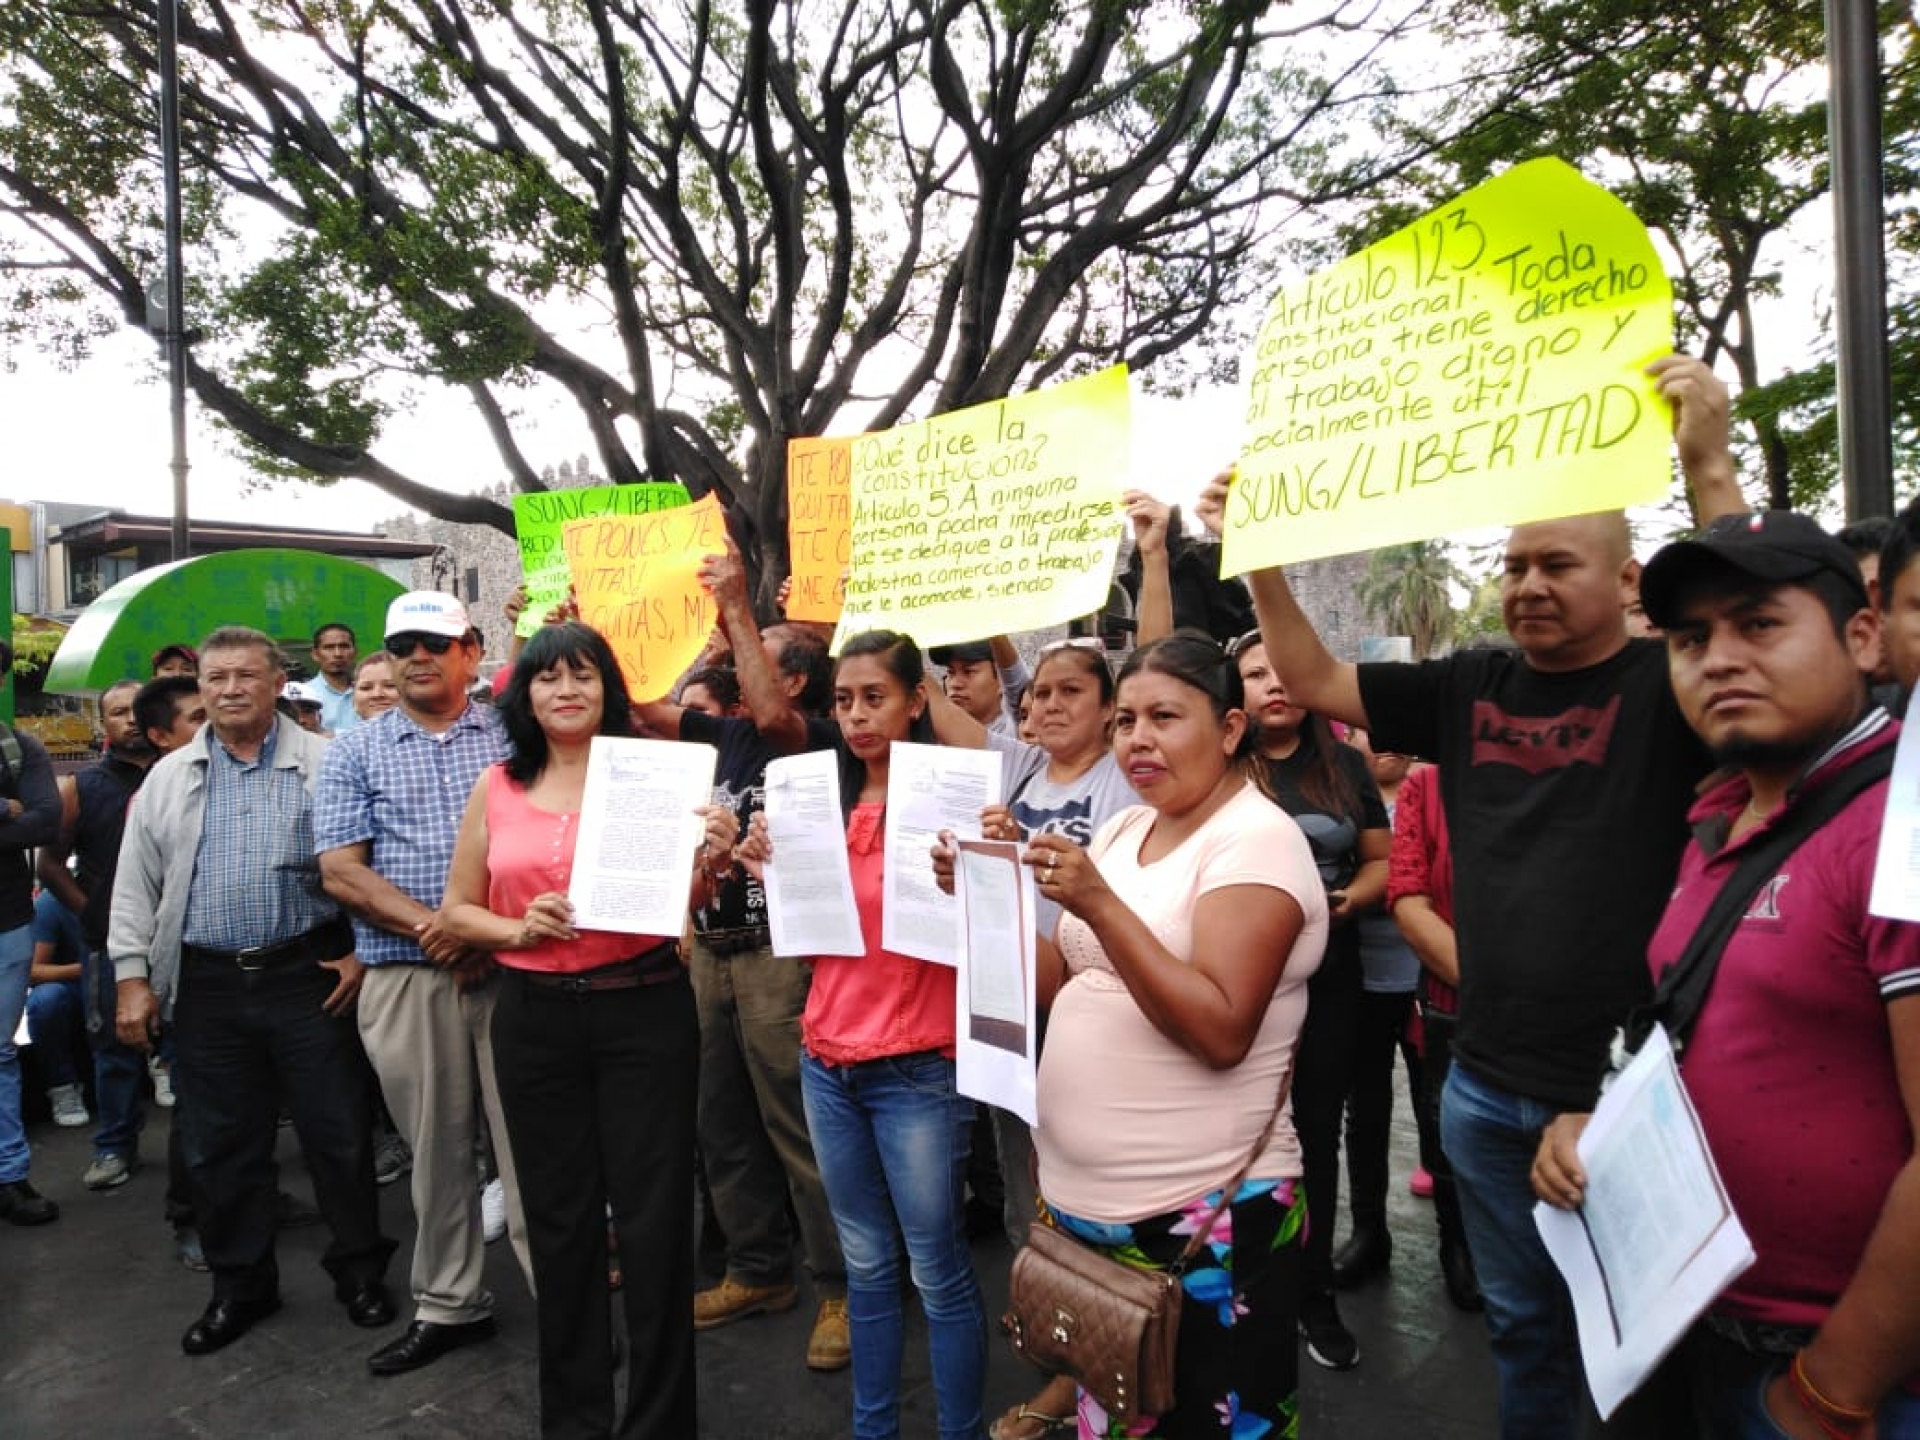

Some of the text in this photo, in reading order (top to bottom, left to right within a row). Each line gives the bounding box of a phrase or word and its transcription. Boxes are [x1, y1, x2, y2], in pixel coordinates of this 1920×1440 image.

[1493, 230, 1596, 295] Toda
[1264, 251, 1396, 336] Artículo
[1251, 258, 1647, 400] persona tiene derecho
[1286, 357, 1420, 413] trabajo
[1442, 327, 1580, 388] digno
[917, 421, 977, 463] dice
[998, 403, 1025, 443] la
[1241, 392, 1432, 458] socialmente
[1235, 384, 1641, 529] SUNG/LIBERTAD
[958, 482, 978, 511] A
[686, 506, 714, 552] TE
[853, 522, 927, 547] persona
[1010, 502, 1113, 531] impedirse
[881, 548, 903, 563] se
[908, 538, 991, 565] dedique
[1022, 531, 1039, 547] la
[800, 575, 824, 606] ME
[929, 557, 1012, 585] comercio
[1019, 557, 1030, 571] o
[1037, 549, 1103, 572] trabajo
[846, 599, 872, 616] que
[880, 596, 892, 611] le
[986, 576, 1054, 597] siendo
